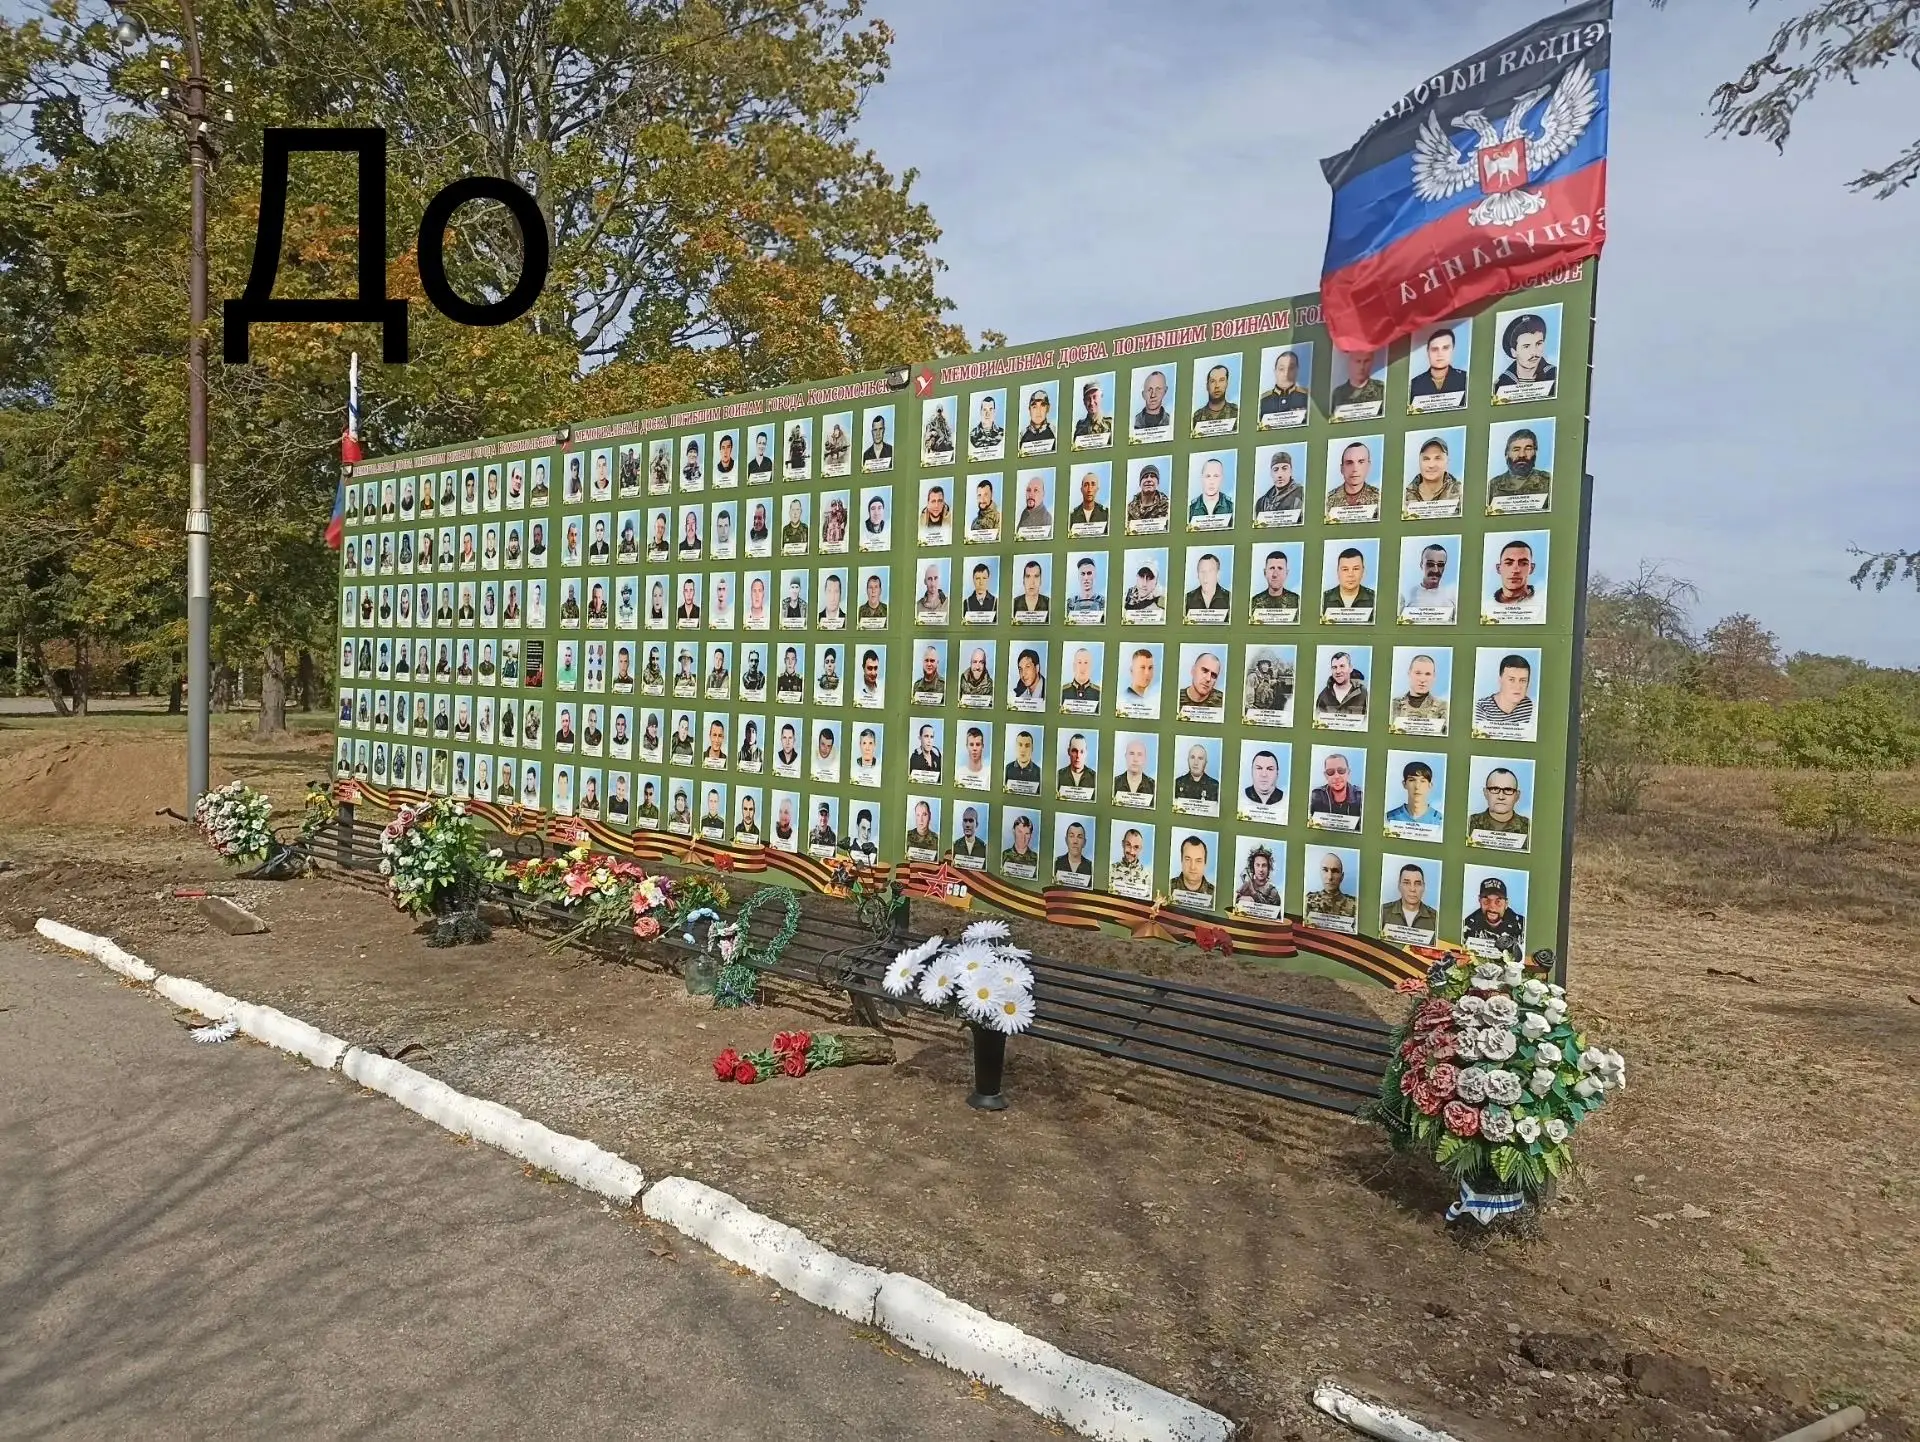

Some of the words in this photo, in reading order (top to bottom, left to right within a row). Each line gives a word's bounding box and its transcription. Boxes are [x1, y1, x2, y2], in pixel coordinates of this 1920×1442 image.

[940, 350, 1054, 384] МЕМОРИАЛЬНАЯ
[1057, 341, 1108, 370] ДОСКА
[1112, 324, 1208, 357] ПОГИБШИМ
[1211, 309, 1291, 341] ВОИНАМ
[574, 419, 639, 443] МЕМОРИАЛЬНАЯ
[639, 415, 669, 435] ДОСКА
[670, 406, 721, 428] ПОГИБШИМ
[722, 399, 764, 420] ВОИНАМ
[765, 393, 805, 413] ГОРОДА
[806, 378, 895, 406] КОМСОМОЛЬСК
[946, 883, 968, 898] СВО
